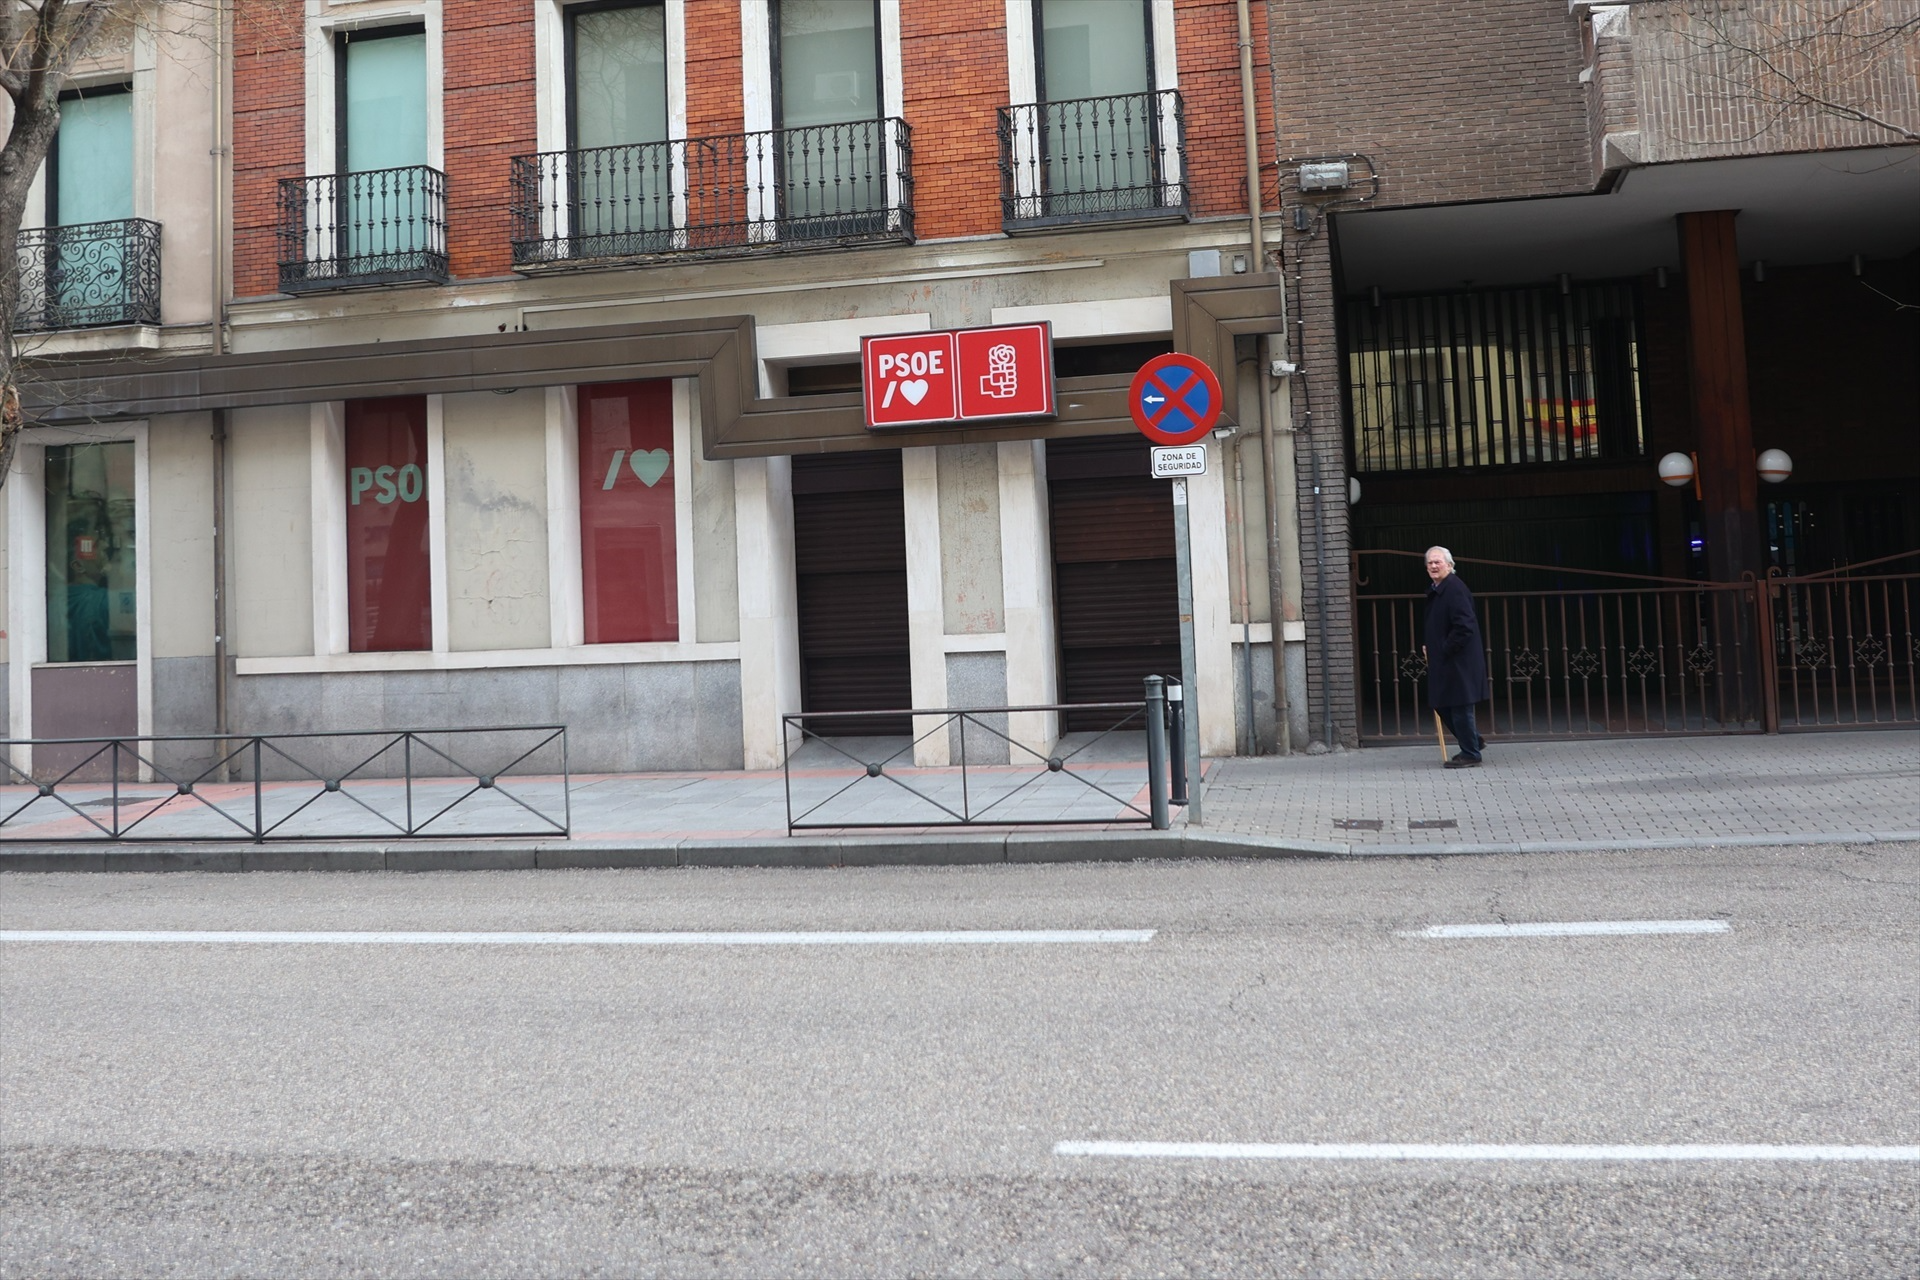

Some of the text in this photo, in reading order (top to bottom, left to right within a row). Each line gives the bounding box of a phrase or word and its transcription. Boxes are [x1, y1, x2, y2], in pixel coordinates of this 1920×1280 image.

[878, 350, 944, 378] PSOE
[1157, 461, 1202, 471] SEGURIDAD
[1161, 452, 1197, 461] ZONA DE
[351, 463, 429, 505] PSO
